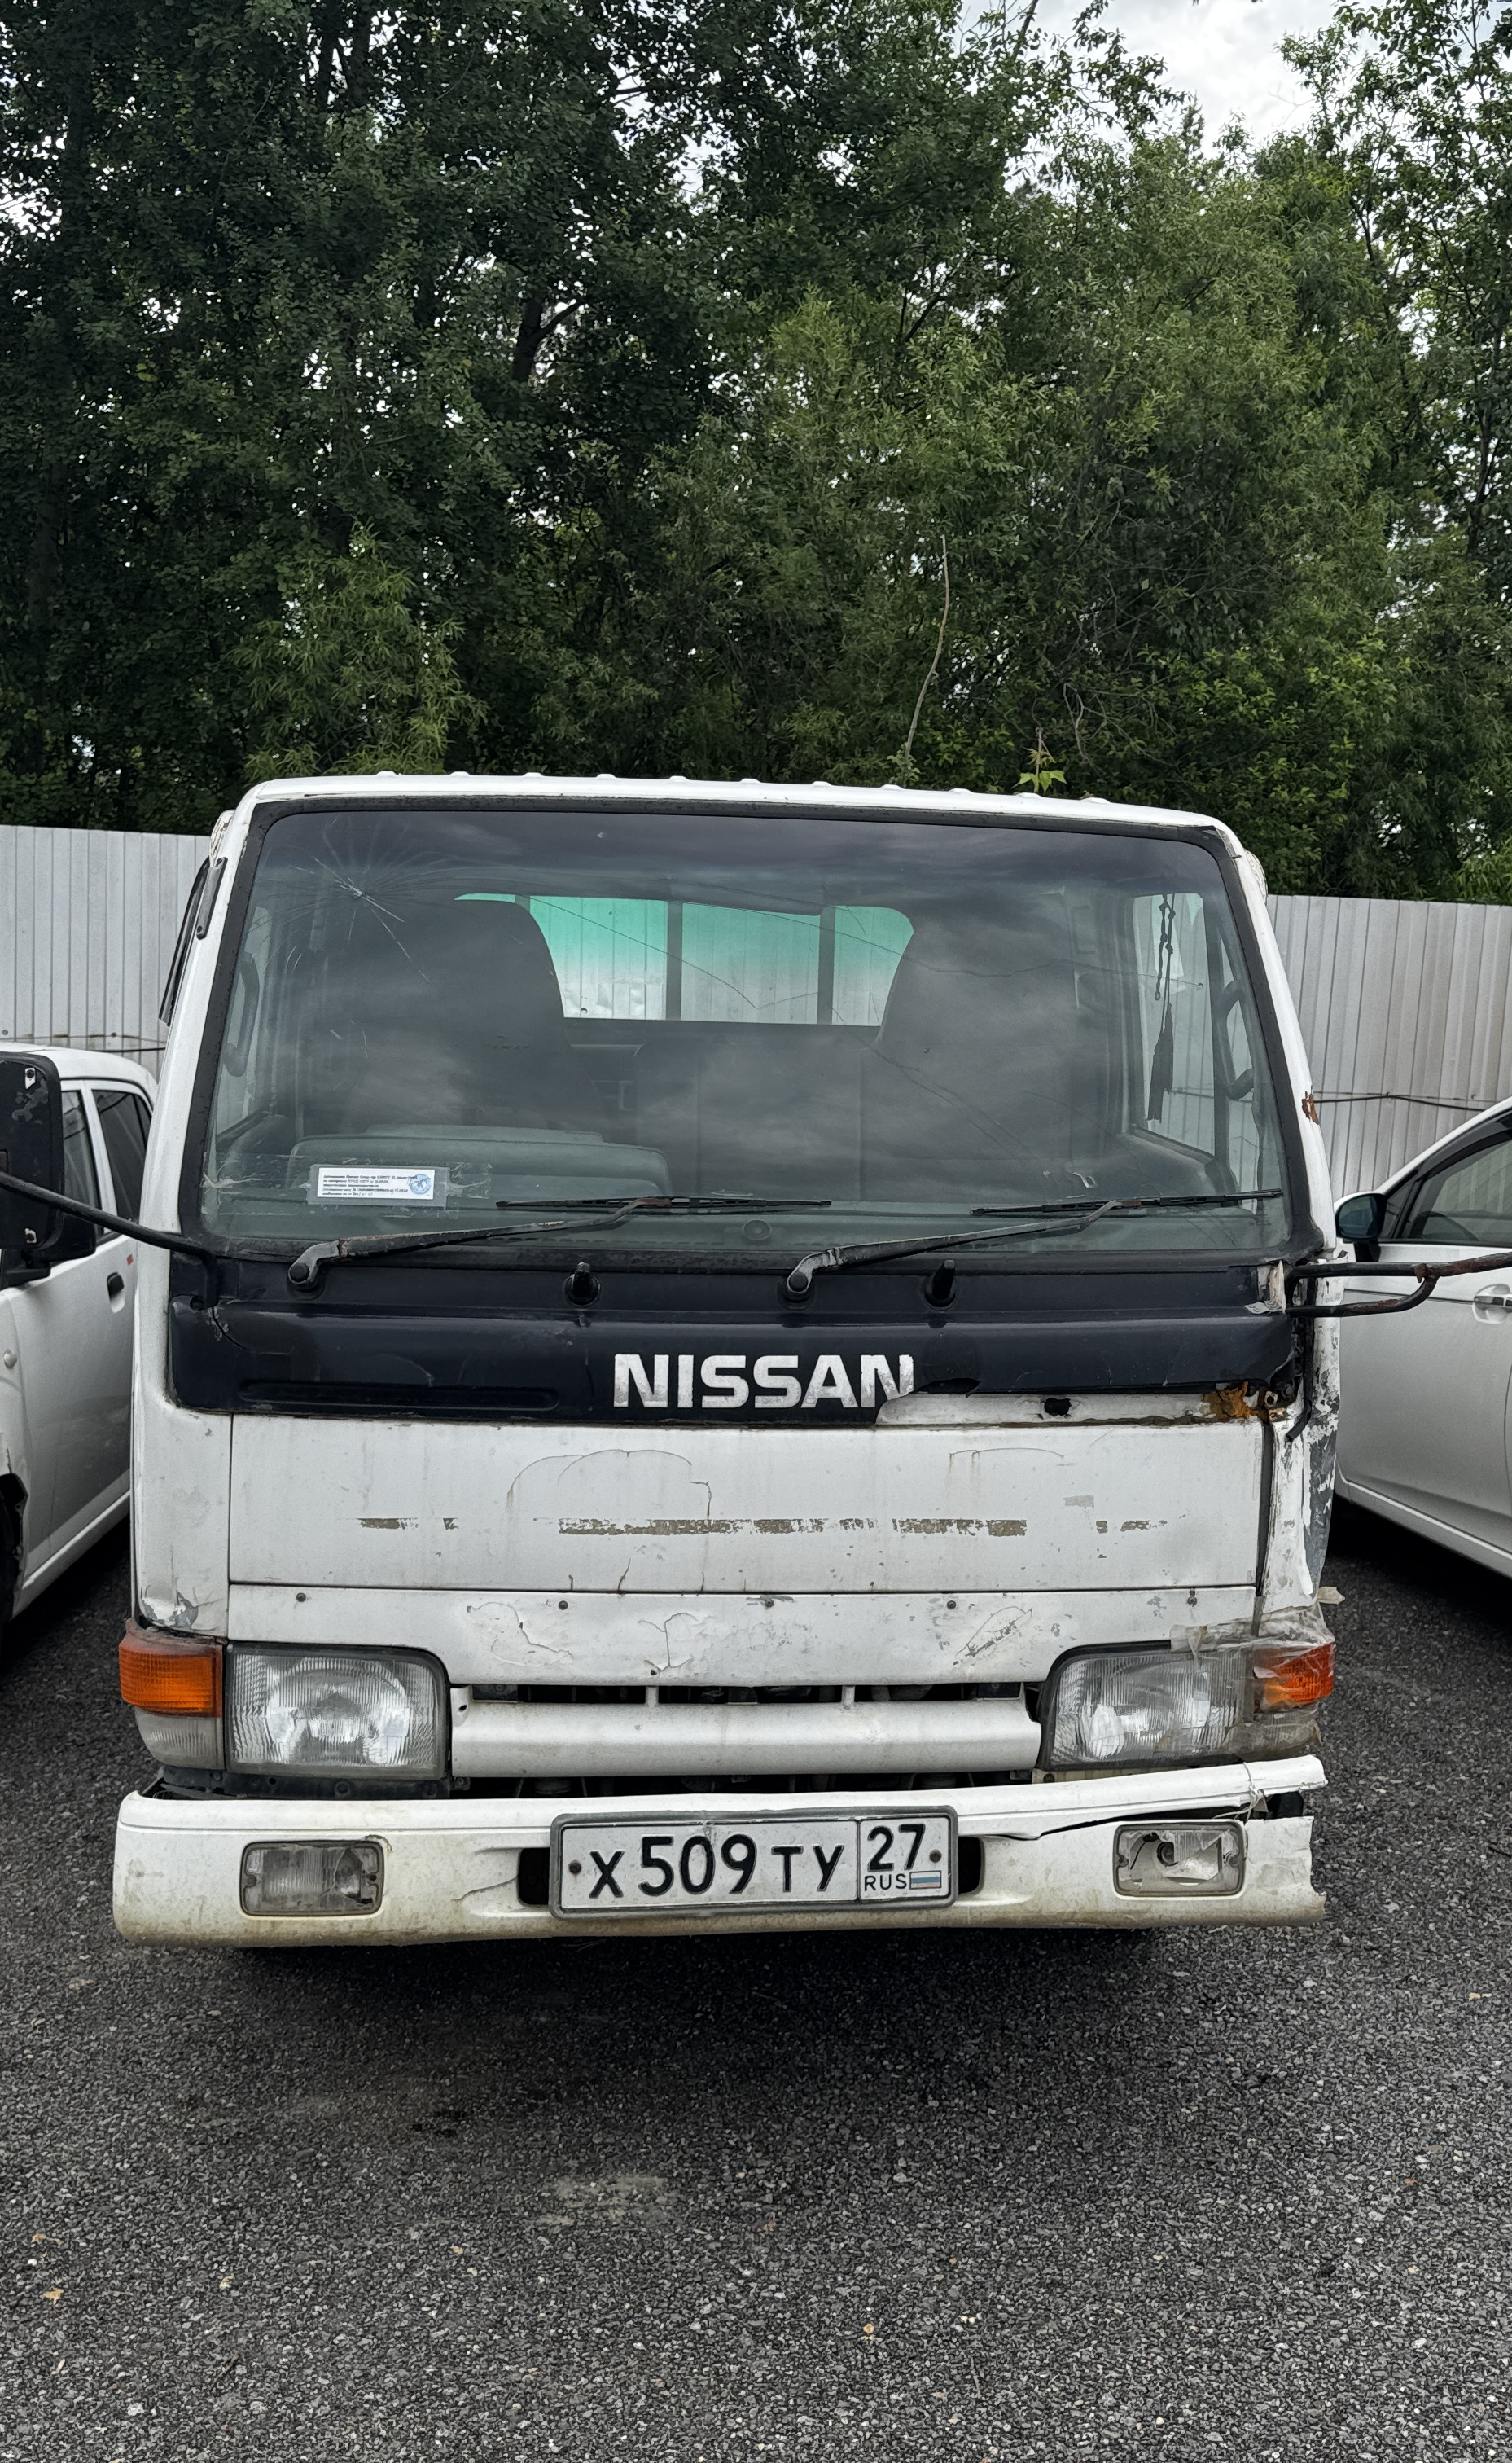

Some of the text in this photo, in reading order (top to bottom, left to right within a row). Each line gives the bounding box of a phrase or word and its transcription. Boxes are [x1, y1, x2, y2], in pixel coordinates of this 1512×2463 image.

[614, 1354, 914, 1407] NISSAN
[867, 1823, 926, 1872] 27
[864, 1874, 907, 1891] RUS
